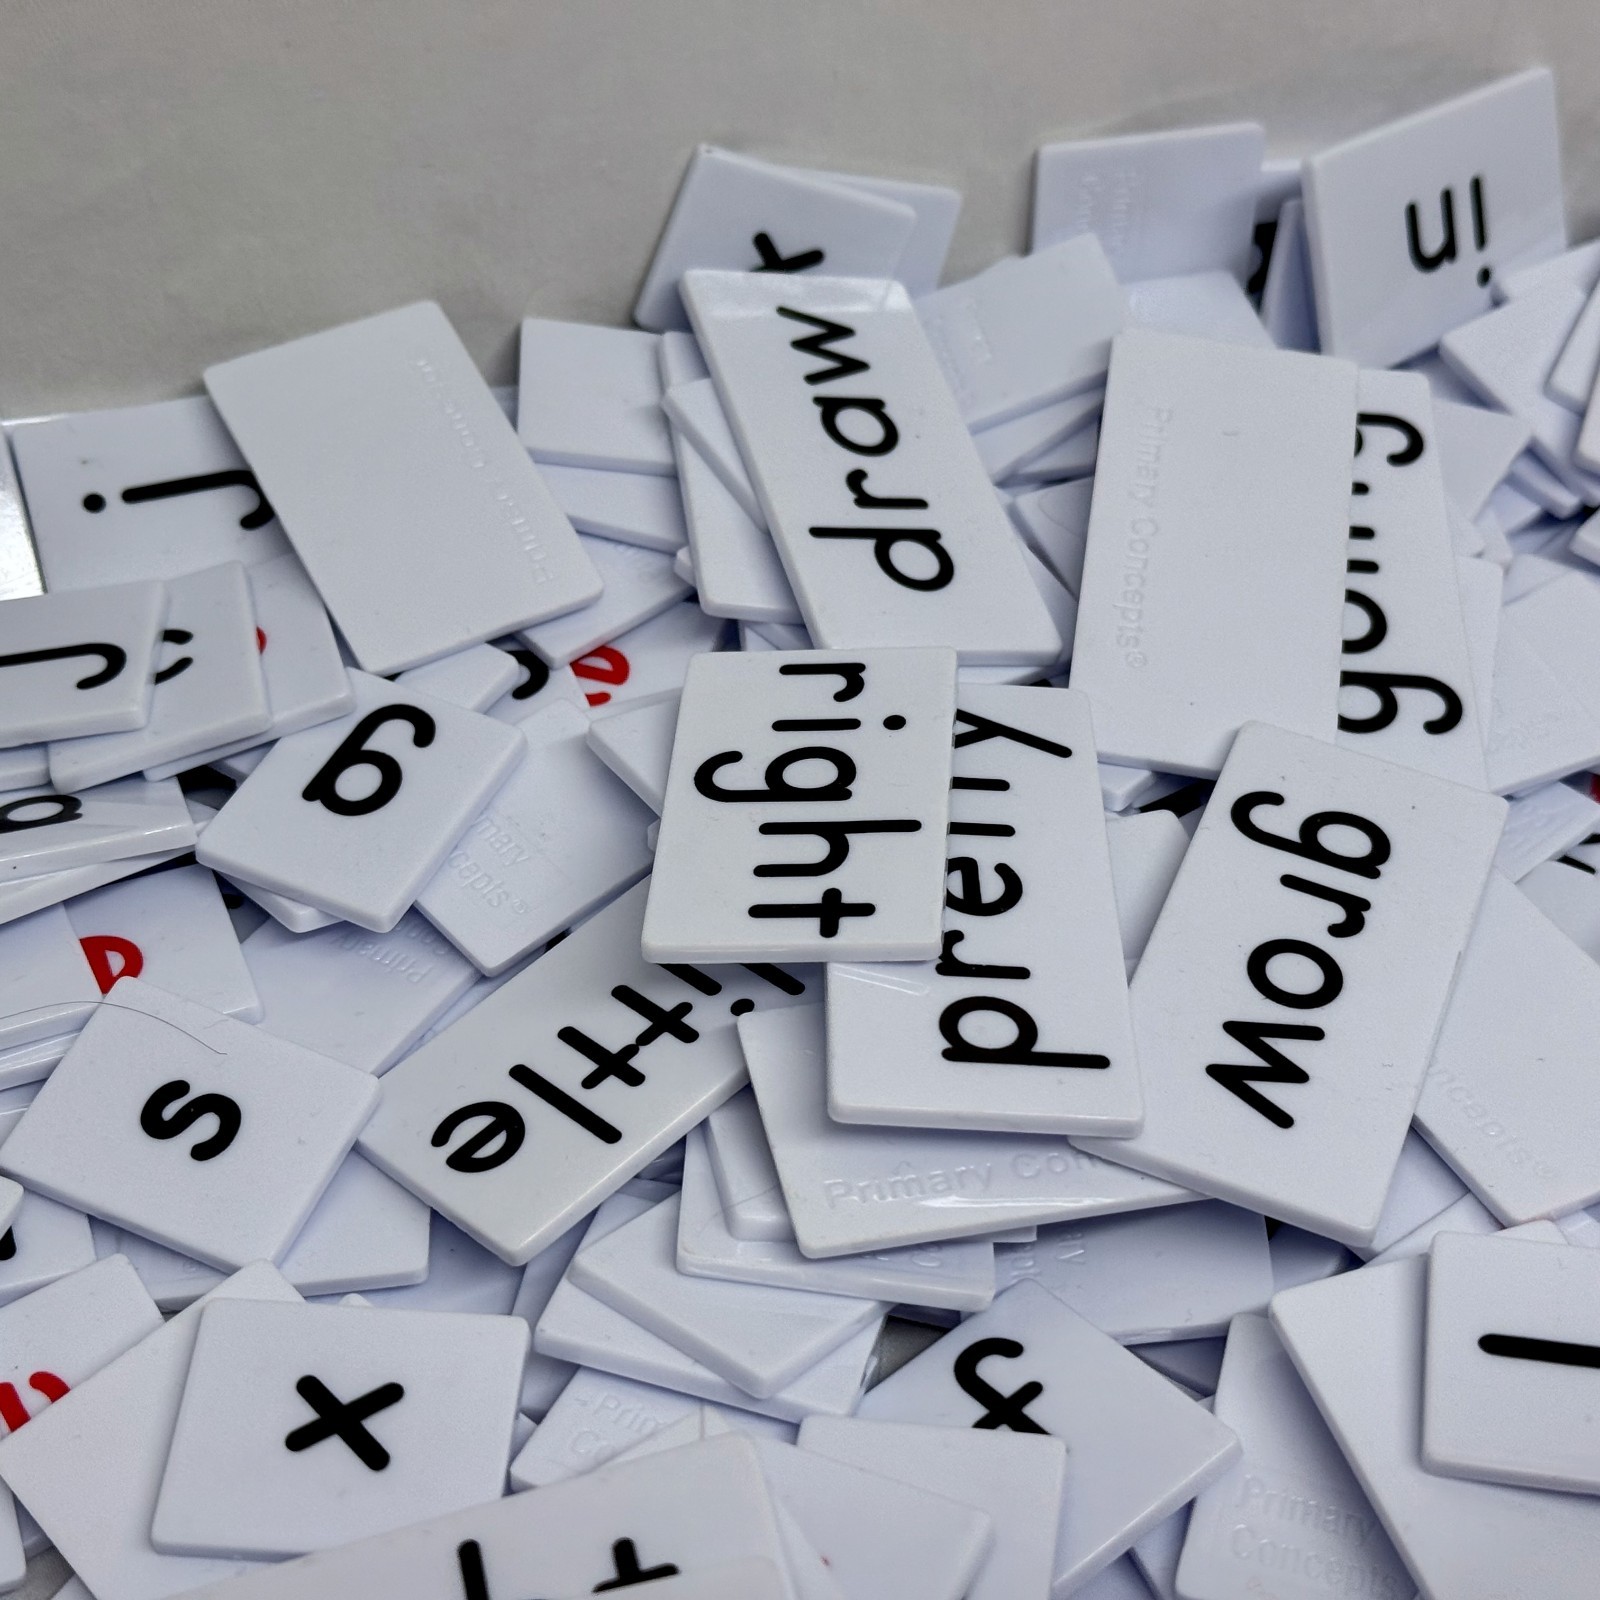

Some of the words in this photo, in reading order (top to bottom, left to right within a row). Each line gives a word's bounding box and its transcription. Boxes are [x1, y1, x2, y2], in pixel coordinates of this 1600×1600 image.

[1405, 175, 1491, 288] in
[775, 305, 956, 593] draw
[1336, 411, 1464, 736] gog
[301, 703, 436, 817] g
[692, 661, 923, 939] right
[473, 815, 530, 868] mary
[1204, 789, 1392, 1130] grow
[139, 1079, 242, 1162] s
[822, 1162, 995, 1208] Primary
[284, 1374, 405, 1472] x
